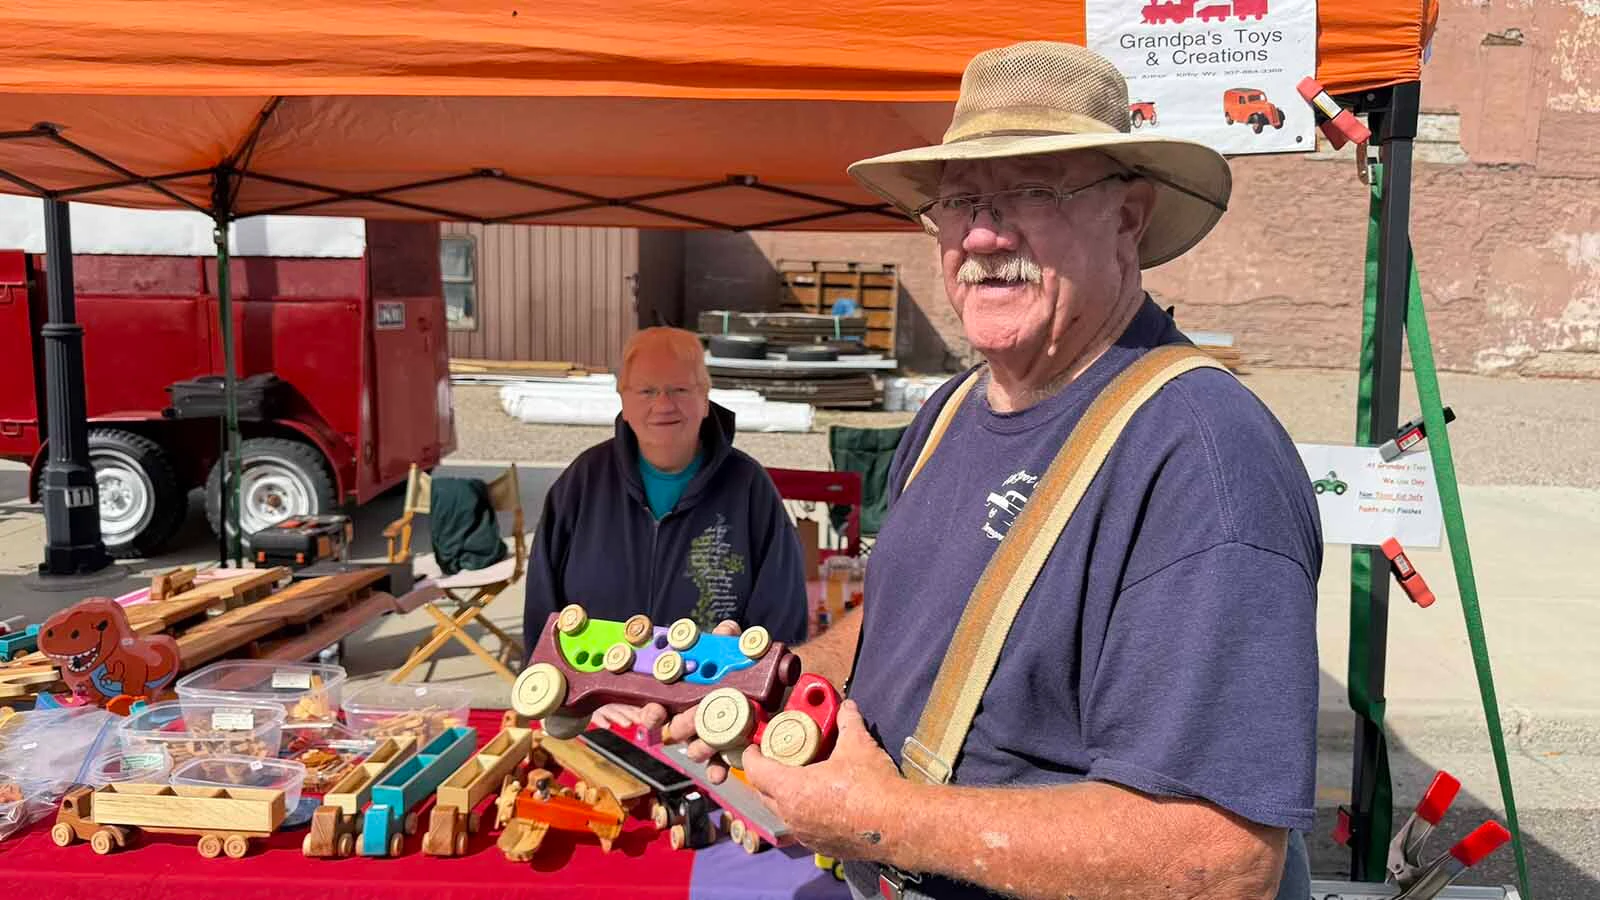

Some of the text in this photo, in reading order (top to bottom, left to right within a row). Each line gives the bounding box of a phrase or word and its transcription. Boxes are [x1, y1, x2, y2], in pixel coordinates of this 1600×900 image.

[1120, 28, 1283, 49] Grandpa's Toys
[1145, 48, 1268, 67] & Creations
